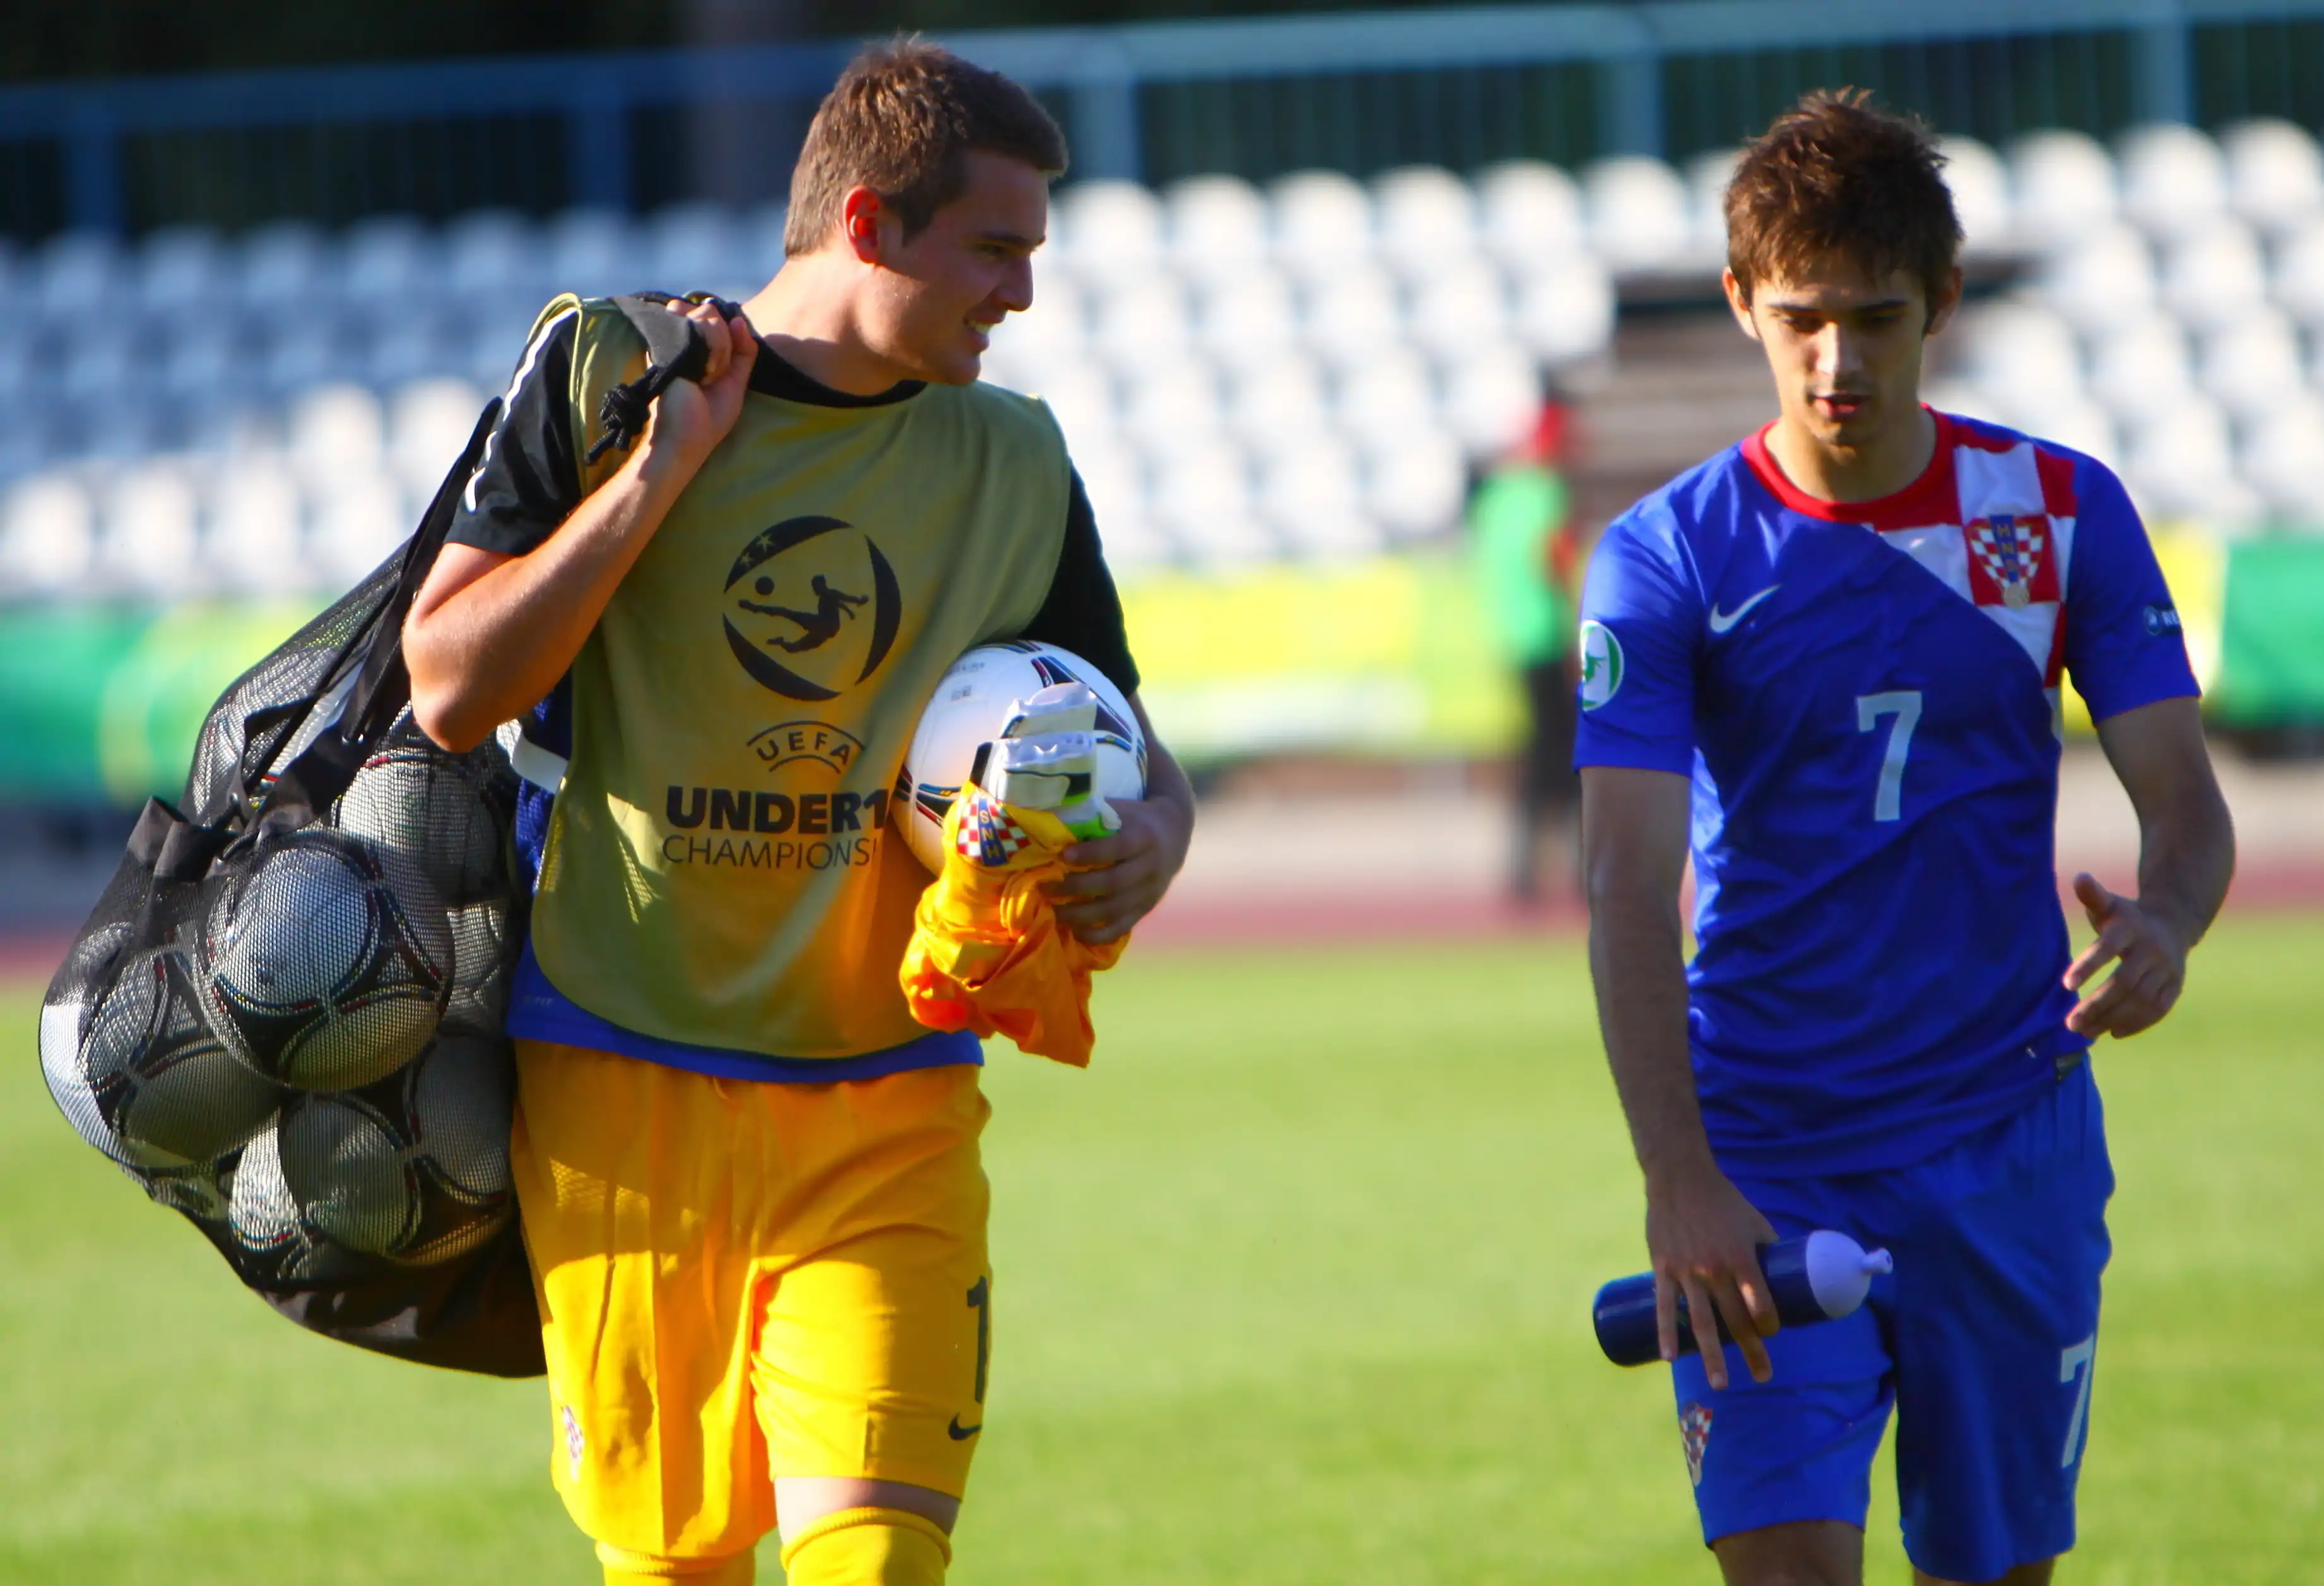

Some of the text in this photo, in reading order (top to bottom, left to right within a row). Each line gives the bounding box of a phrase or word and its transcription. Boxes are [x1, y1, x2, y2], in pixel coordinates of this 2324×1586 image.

[757, 731, 851, 766] UEFA
[1856, 690, 1922, 821] 7
[967, 1275, 988, 1404] 1
[2060, 1332, 2094, 1468] 7
